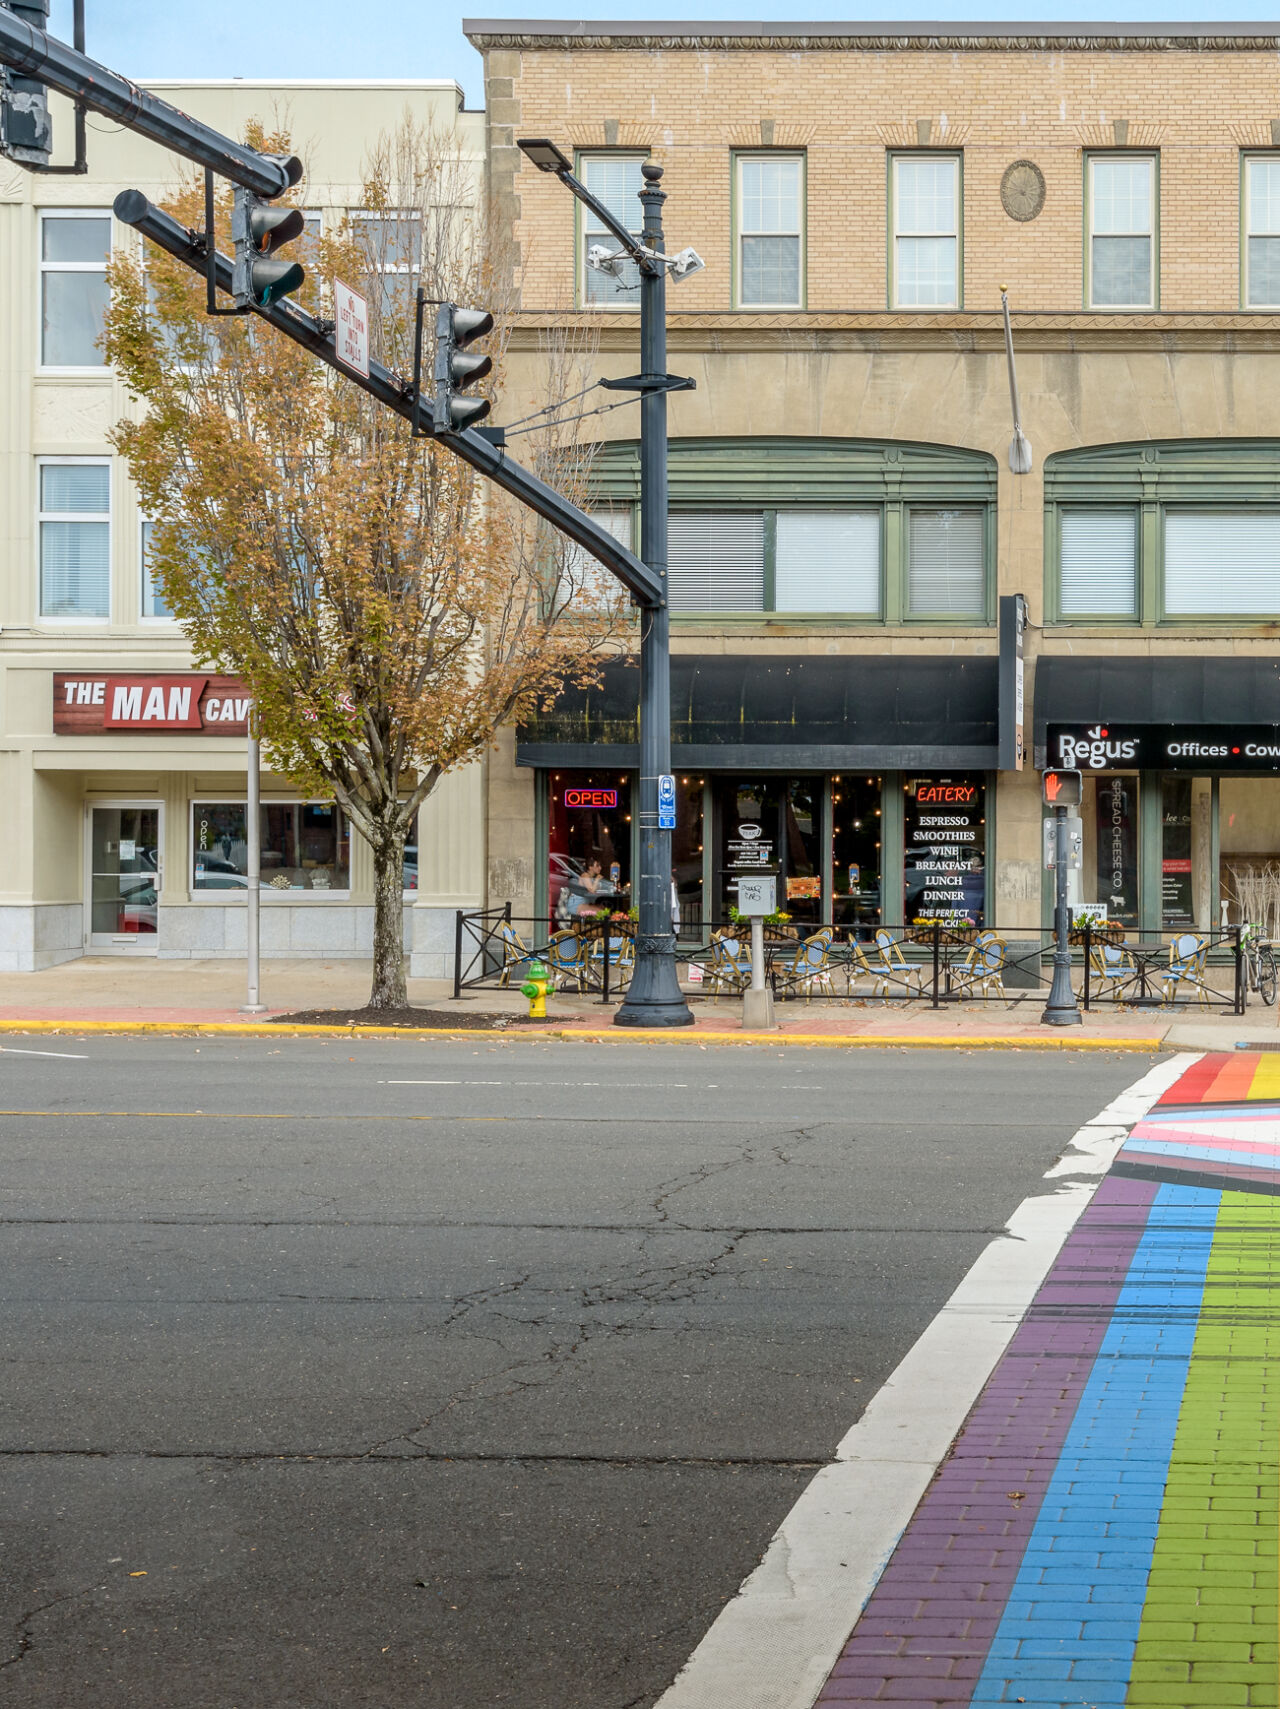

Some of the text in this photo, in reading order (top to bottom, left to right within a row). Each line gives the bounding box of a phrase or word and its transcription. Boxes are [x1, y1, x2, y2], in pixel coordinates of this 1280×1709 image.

[341, 306, 364, 333] LEFT TURN
[64, 682, 257, 721] THE MAN CAV
[1167, 742, 1228, 756] Offices
[568, 792, 614, 805] OPEN
[917, 786, 975, 802] EATERY
[1112, 780, 1122, 825] SPREAD
[919, 816, 969, 826] ESPRESSO
[913, 831, 975, 841] SMOOTHIES
[929, 846, 959, 856] WINE
[1112, 827, 1122, 869] CHEESE
[915, 861, 973, 870] BREAKFAST
[925, 876, 963, 885] LUNCH
[923, 891, 965, 900] DINNER
[918, 909, 970, 917] THE PERFECT
